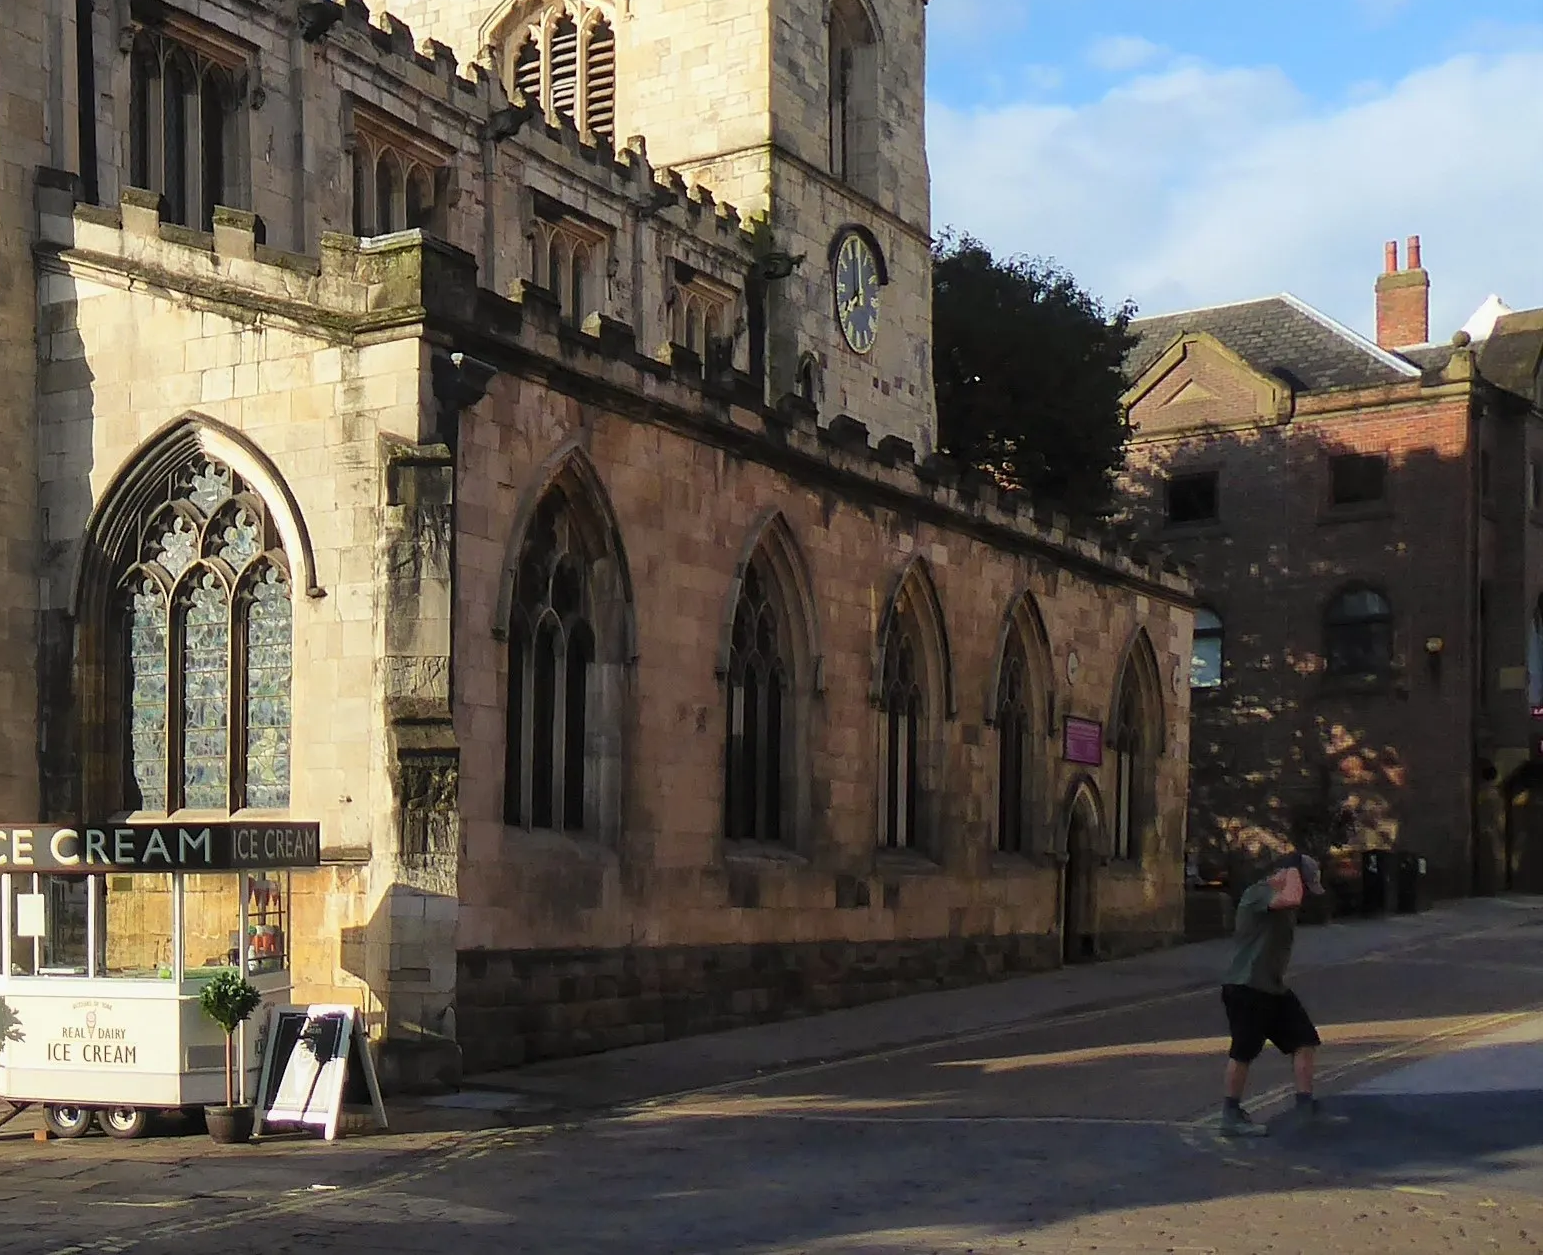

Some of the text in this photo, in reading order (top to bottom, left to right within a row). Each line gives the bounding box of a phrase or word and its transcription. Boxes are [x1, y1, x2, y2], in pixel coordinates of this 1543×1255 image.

[50, 828, 213, 865] CREAM
[232, 829, 316, 861] ICE CREAM
[62, 1027, 126, 1039] REAL DAIRY
[47, 1043, 137, 1064] ICE CREAM
